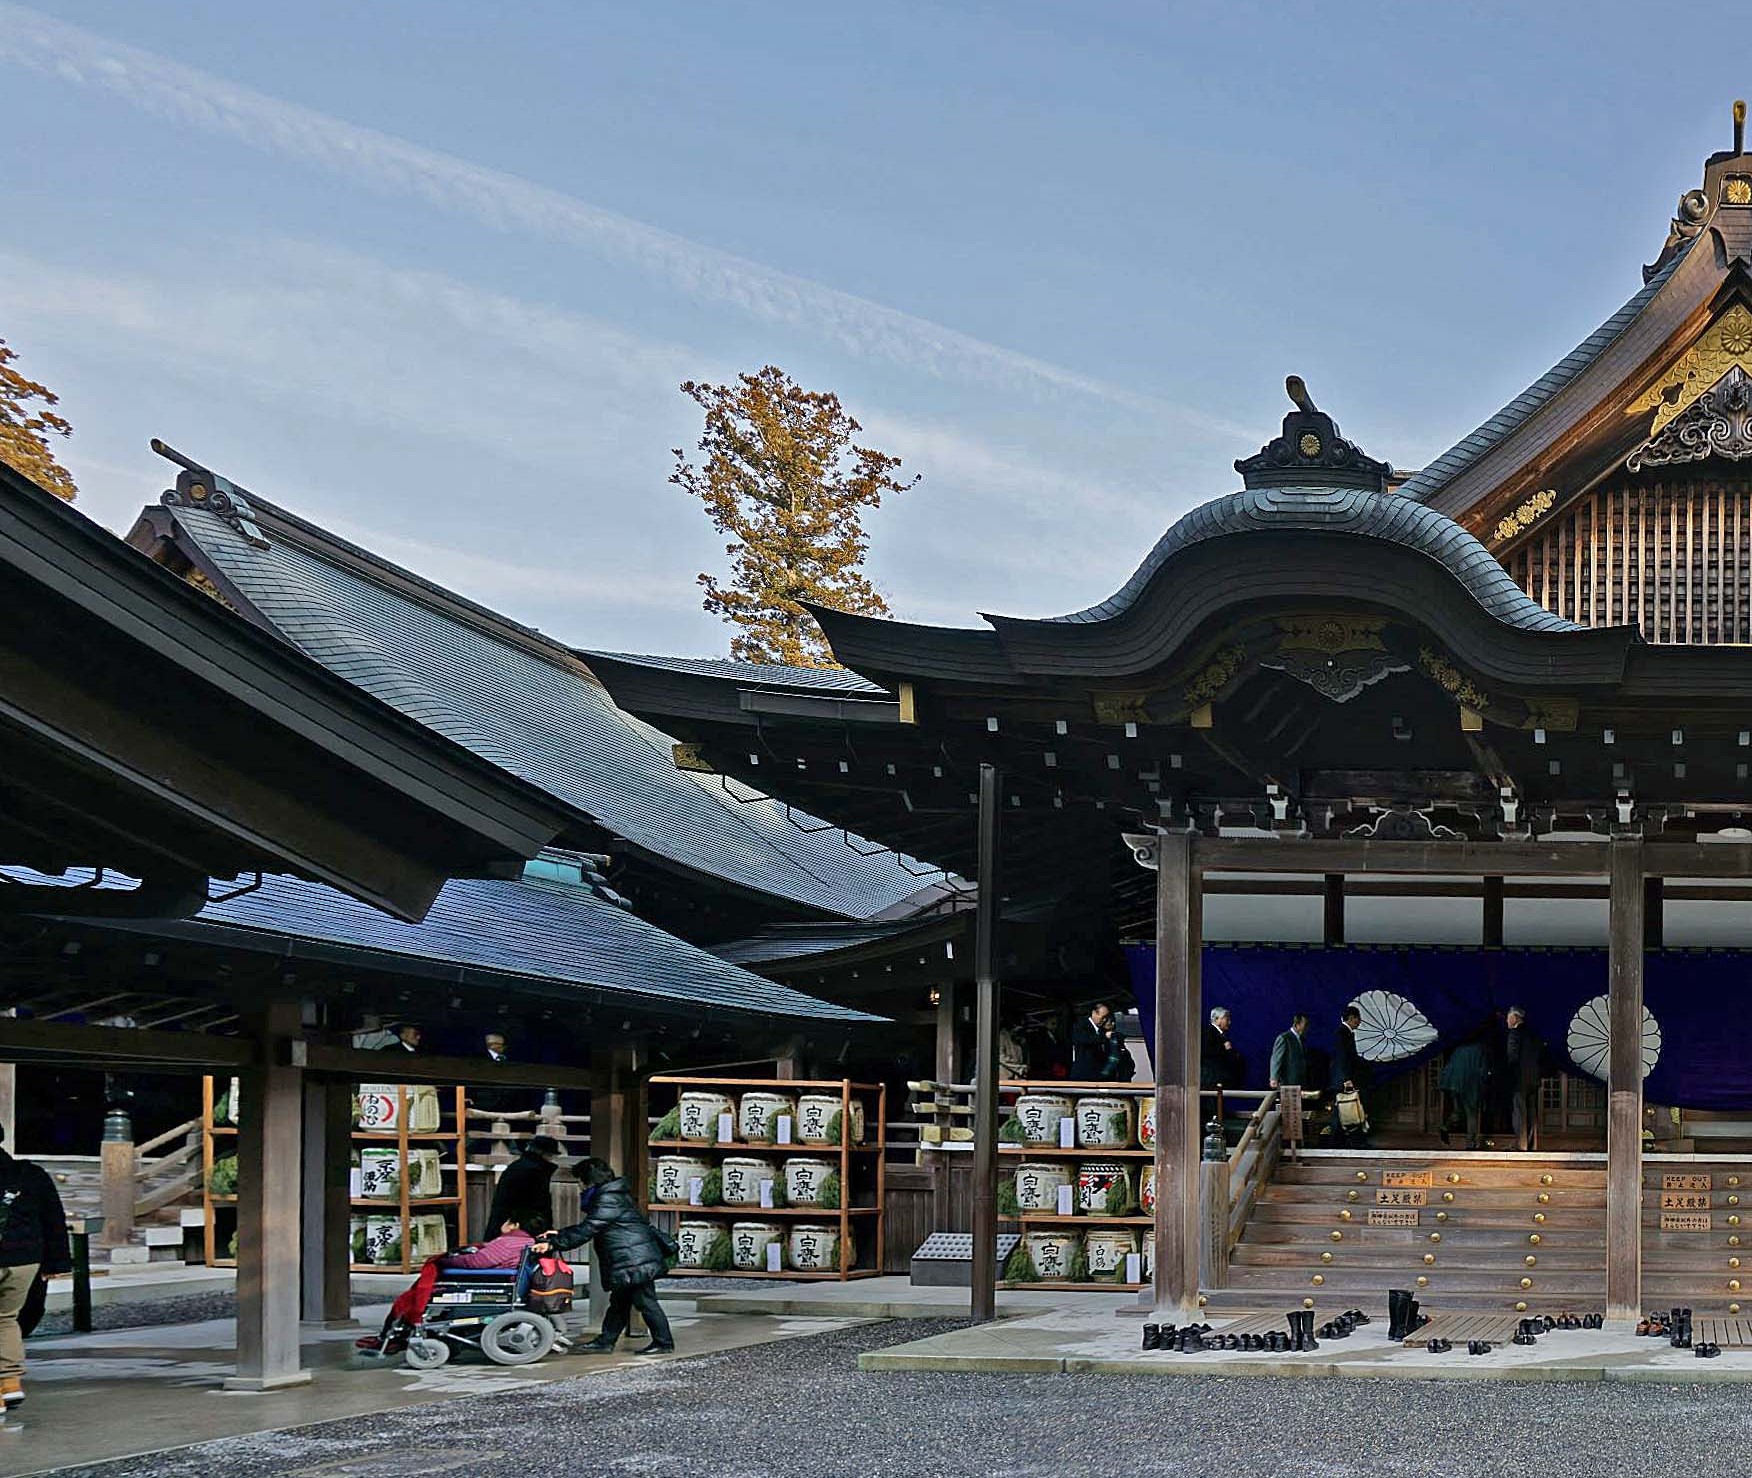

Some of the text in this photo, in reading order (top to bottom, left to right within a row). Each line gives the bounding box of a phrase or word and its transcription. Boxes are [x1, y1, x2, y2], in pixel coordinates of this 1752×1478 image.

[1380, 1194, 1422, 1204] 土足厳禁
[1664, 1197, 1707, 1208] 土足厳禁
